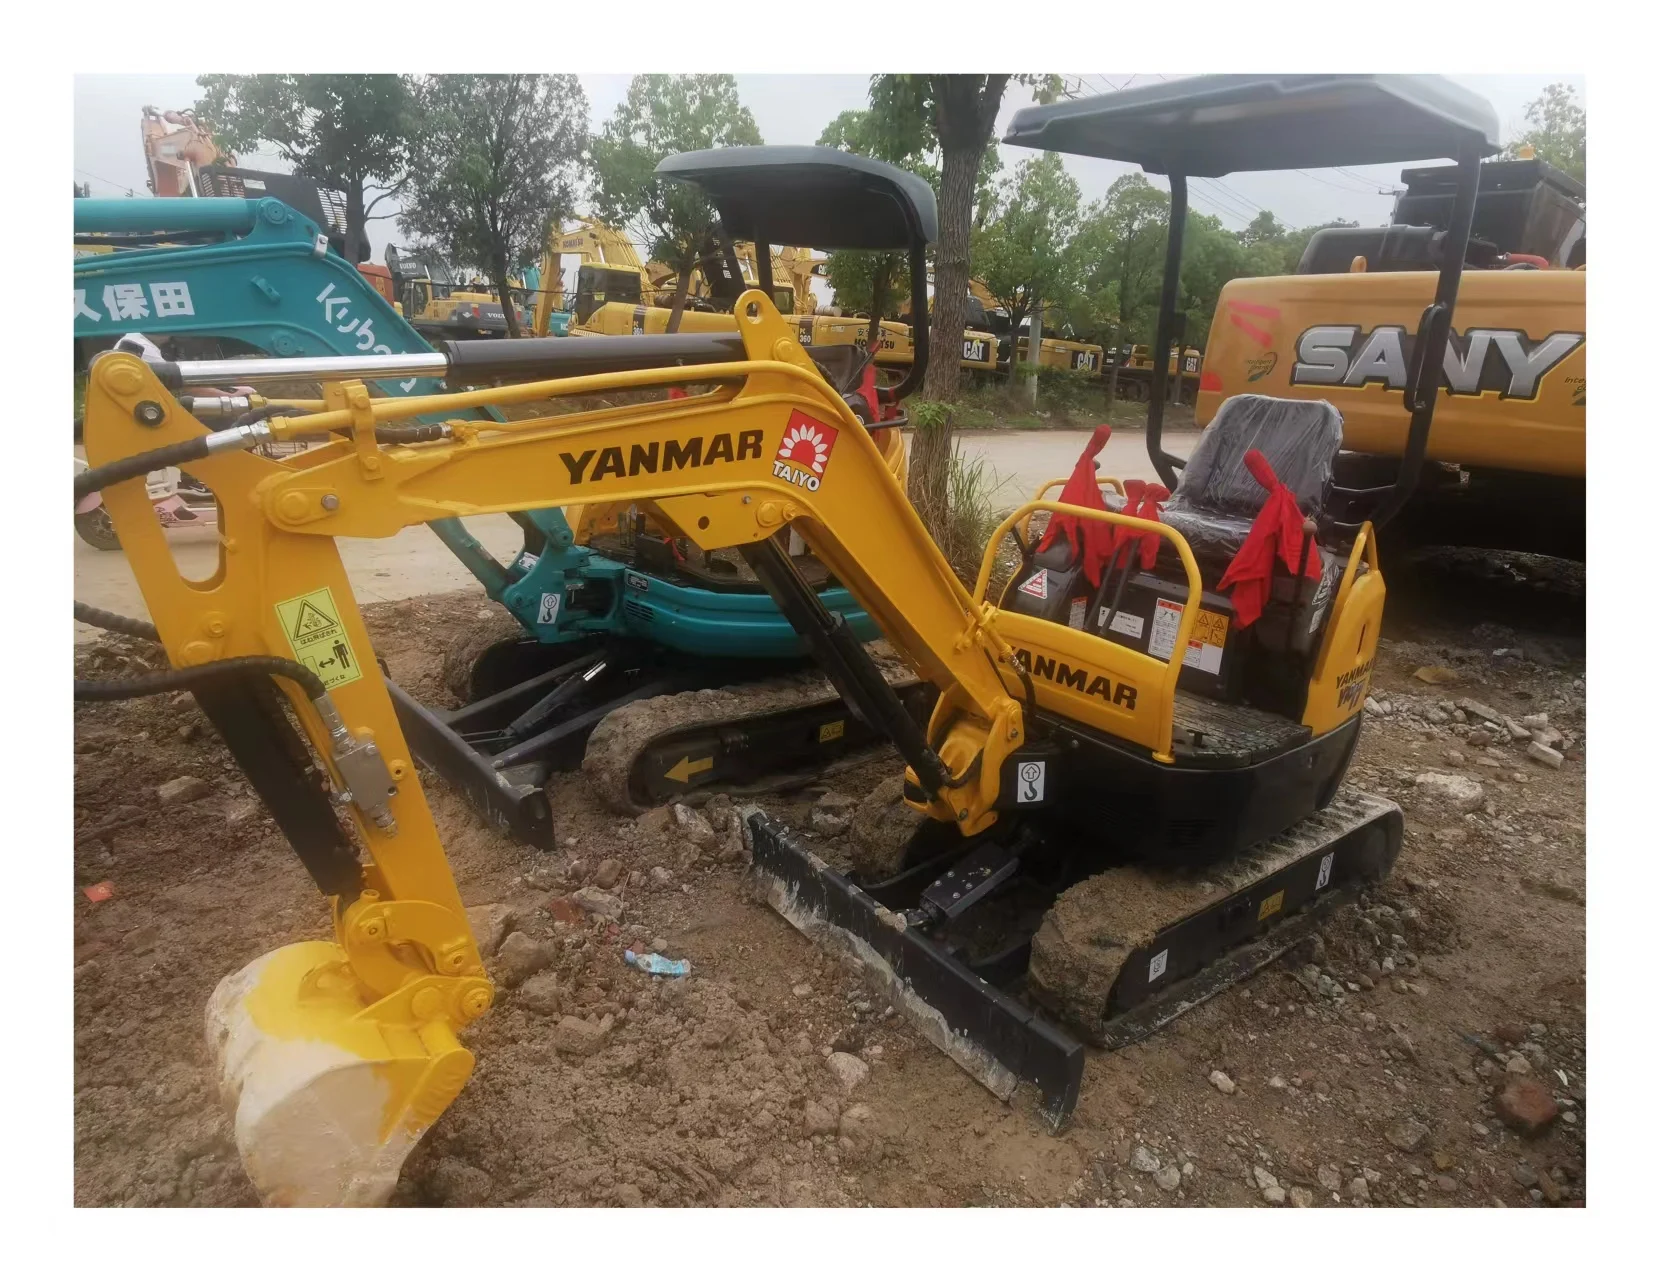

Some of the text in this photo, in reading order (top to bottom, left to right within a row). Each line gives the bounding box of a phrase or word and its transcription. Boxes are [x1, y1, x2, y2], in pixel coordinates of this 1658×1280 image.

[487, 312, 506, 320] VOLV
[854, 338, 895, 350] KOTSU
[963, 340, 984, 361] CAT
[1077, 350, 1095, 371] CAT
[1186, 357, 1197, 372] CAT
[1293, 325, 1584, 399] SANY
[558, 428, 764, 485] YANMAR
[772, 459, 821, 492] TAIYO
[998, 646, 1138, 711] ANMAR
